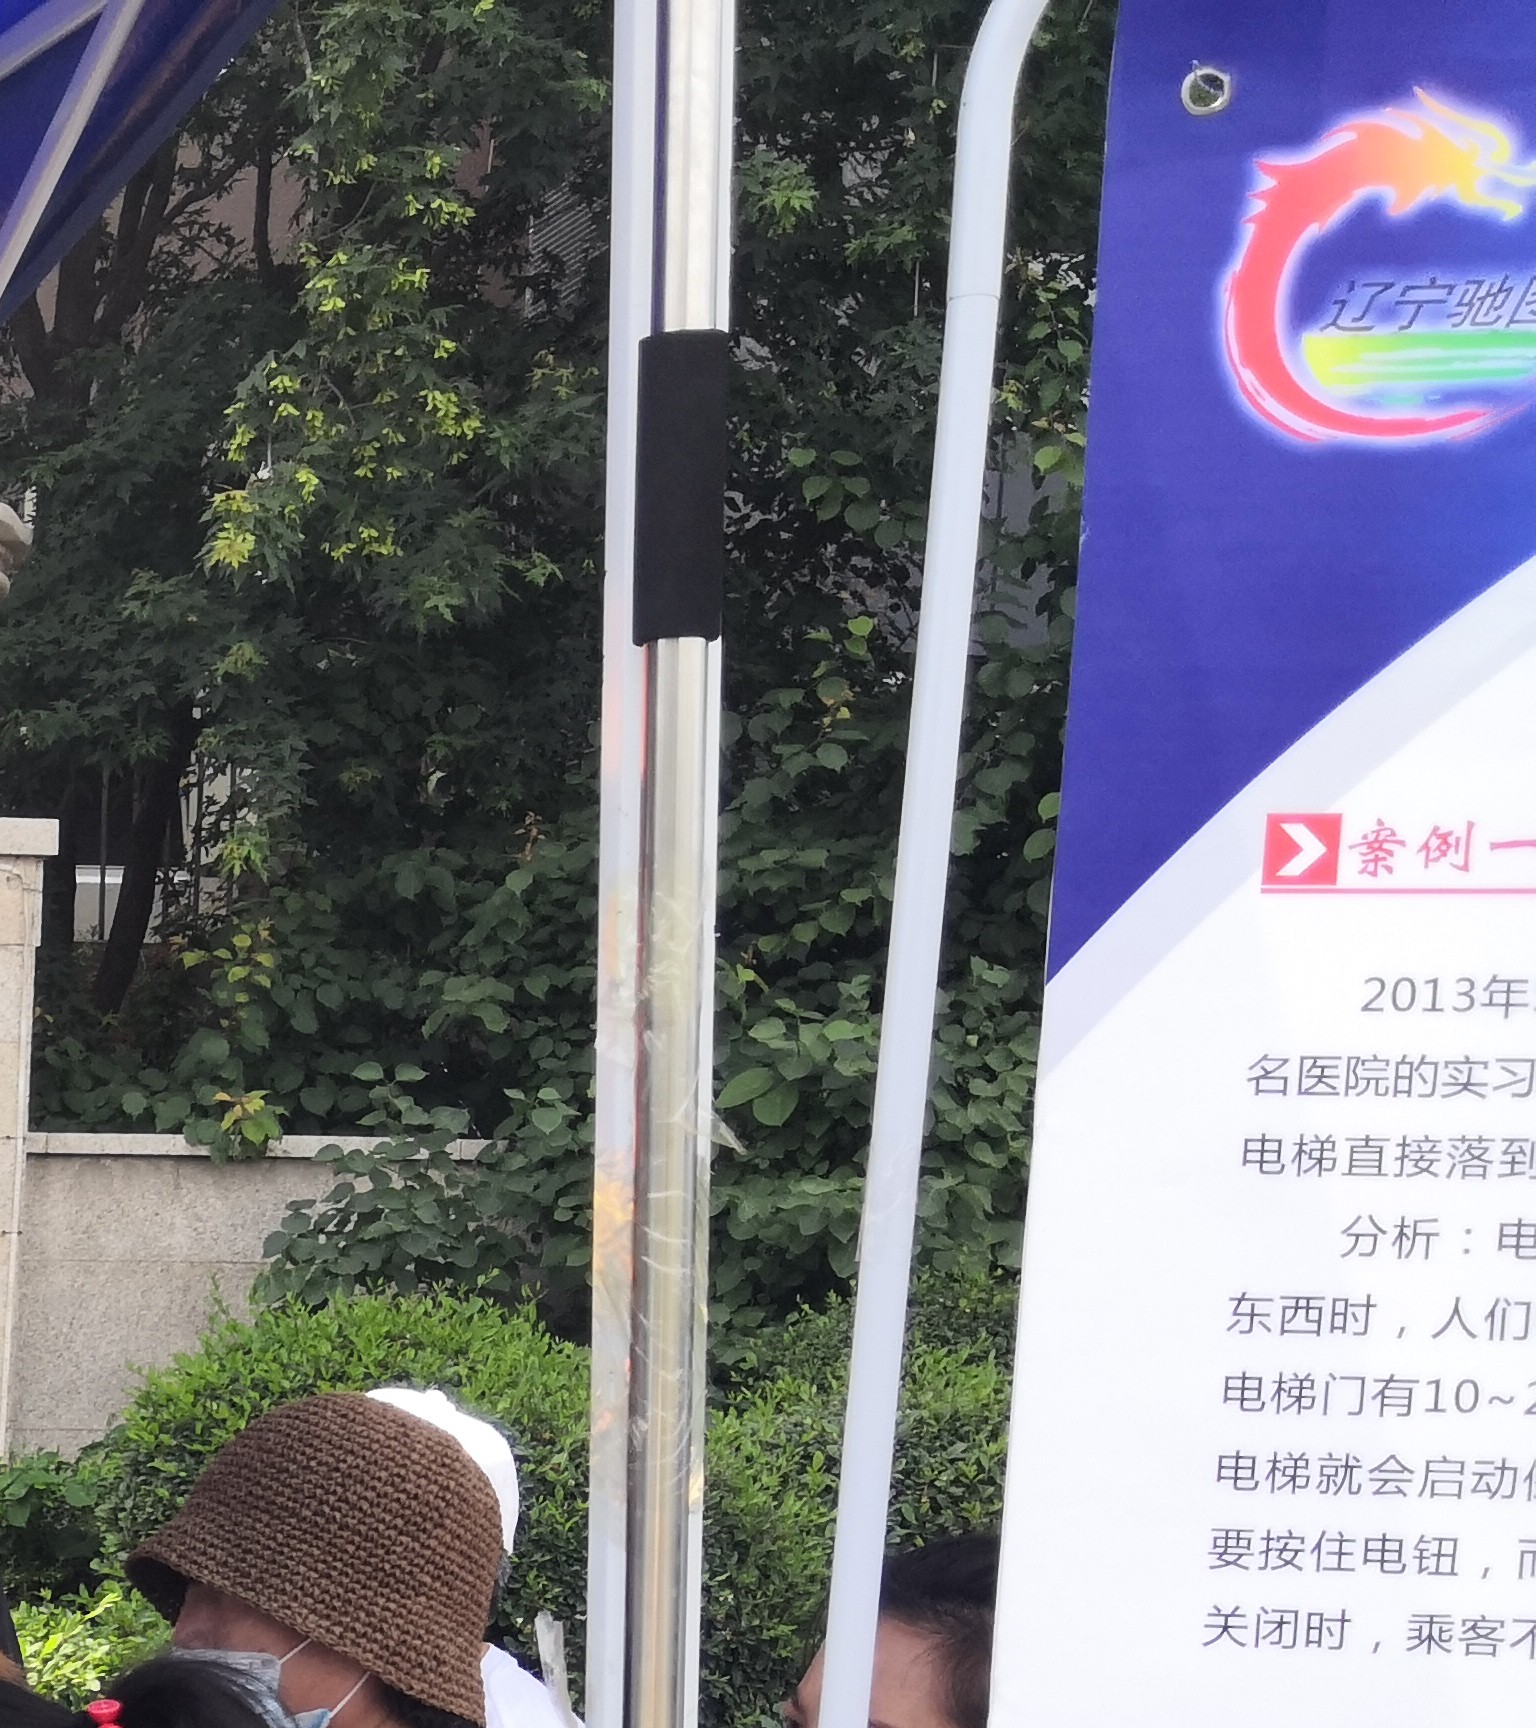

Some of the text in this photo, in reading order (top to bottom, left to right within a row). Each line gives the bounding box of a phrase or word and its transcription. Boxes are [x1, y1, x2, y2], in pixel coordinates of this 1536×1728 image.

[1360, 974, 1530, 1019] 2013年
[1247, 1054, 1535, 1099] 名医院的实习
[1241, 1132, 1536, 1180] 电梯直接落到
[1340, 1214, 1536, 1260] 分析：电
[1227, 1292, 1533, 1342] 东西时，人们
[1217, 1450, 1536, 1501] 电梯就会启动
